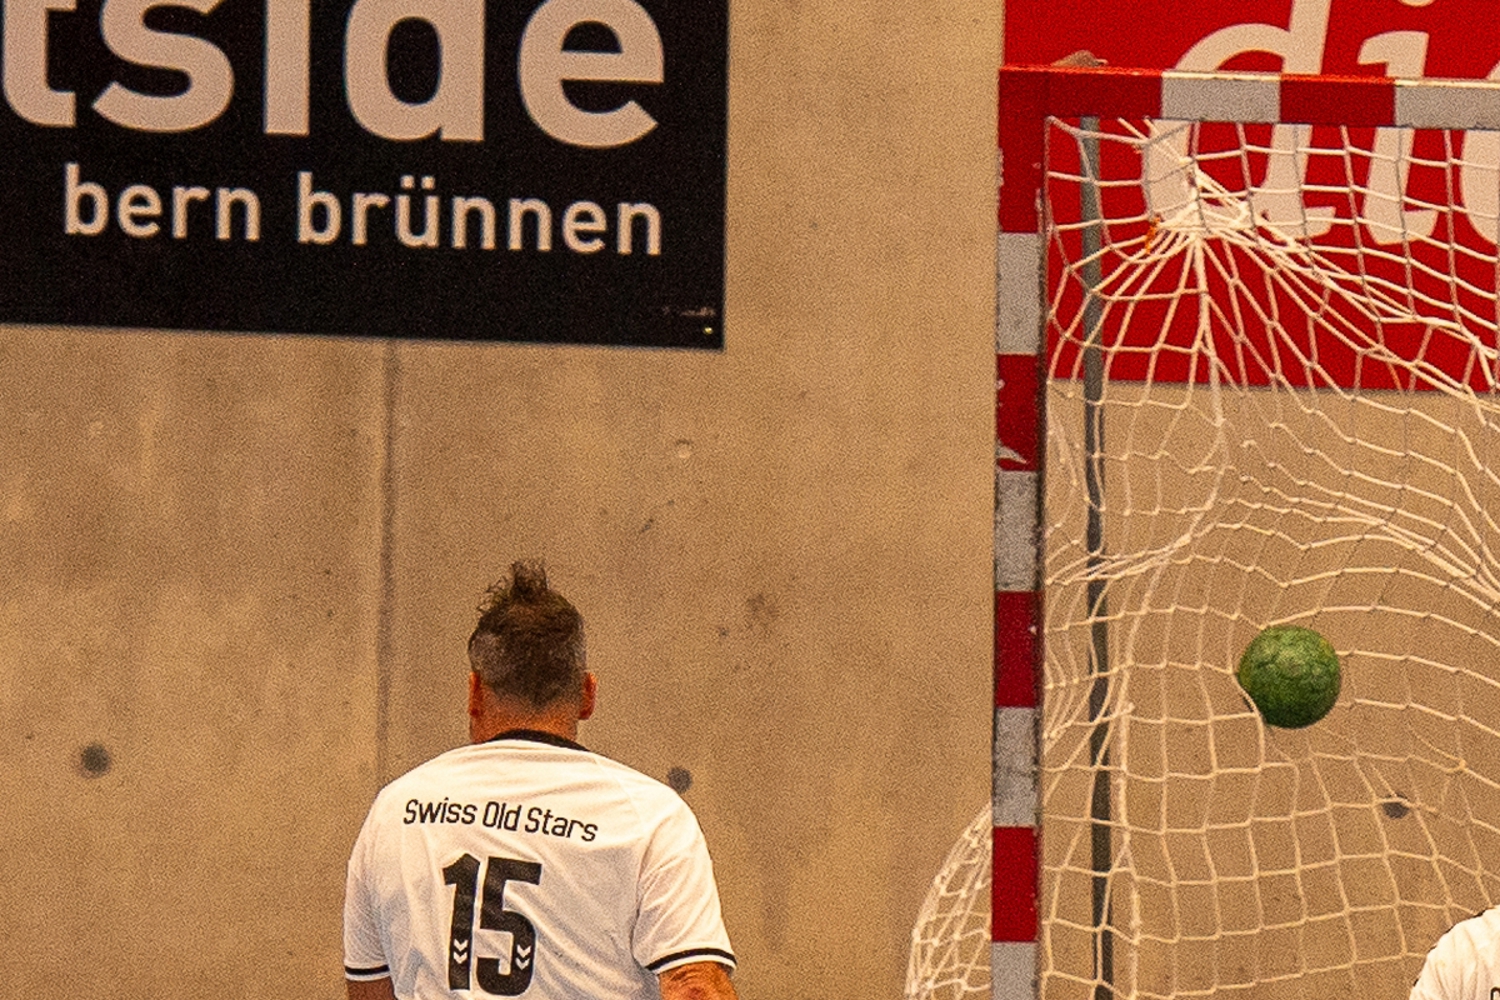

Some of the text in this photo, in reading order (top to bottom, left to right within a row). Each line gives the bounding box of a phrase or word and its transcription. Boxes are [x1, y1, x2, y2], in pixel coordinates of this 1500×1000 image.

[64, 162, 662, 256] bern brünnen
[403, 797, 599, 842] Swiss Old Stars
[442, 853, 543, 997] 15
